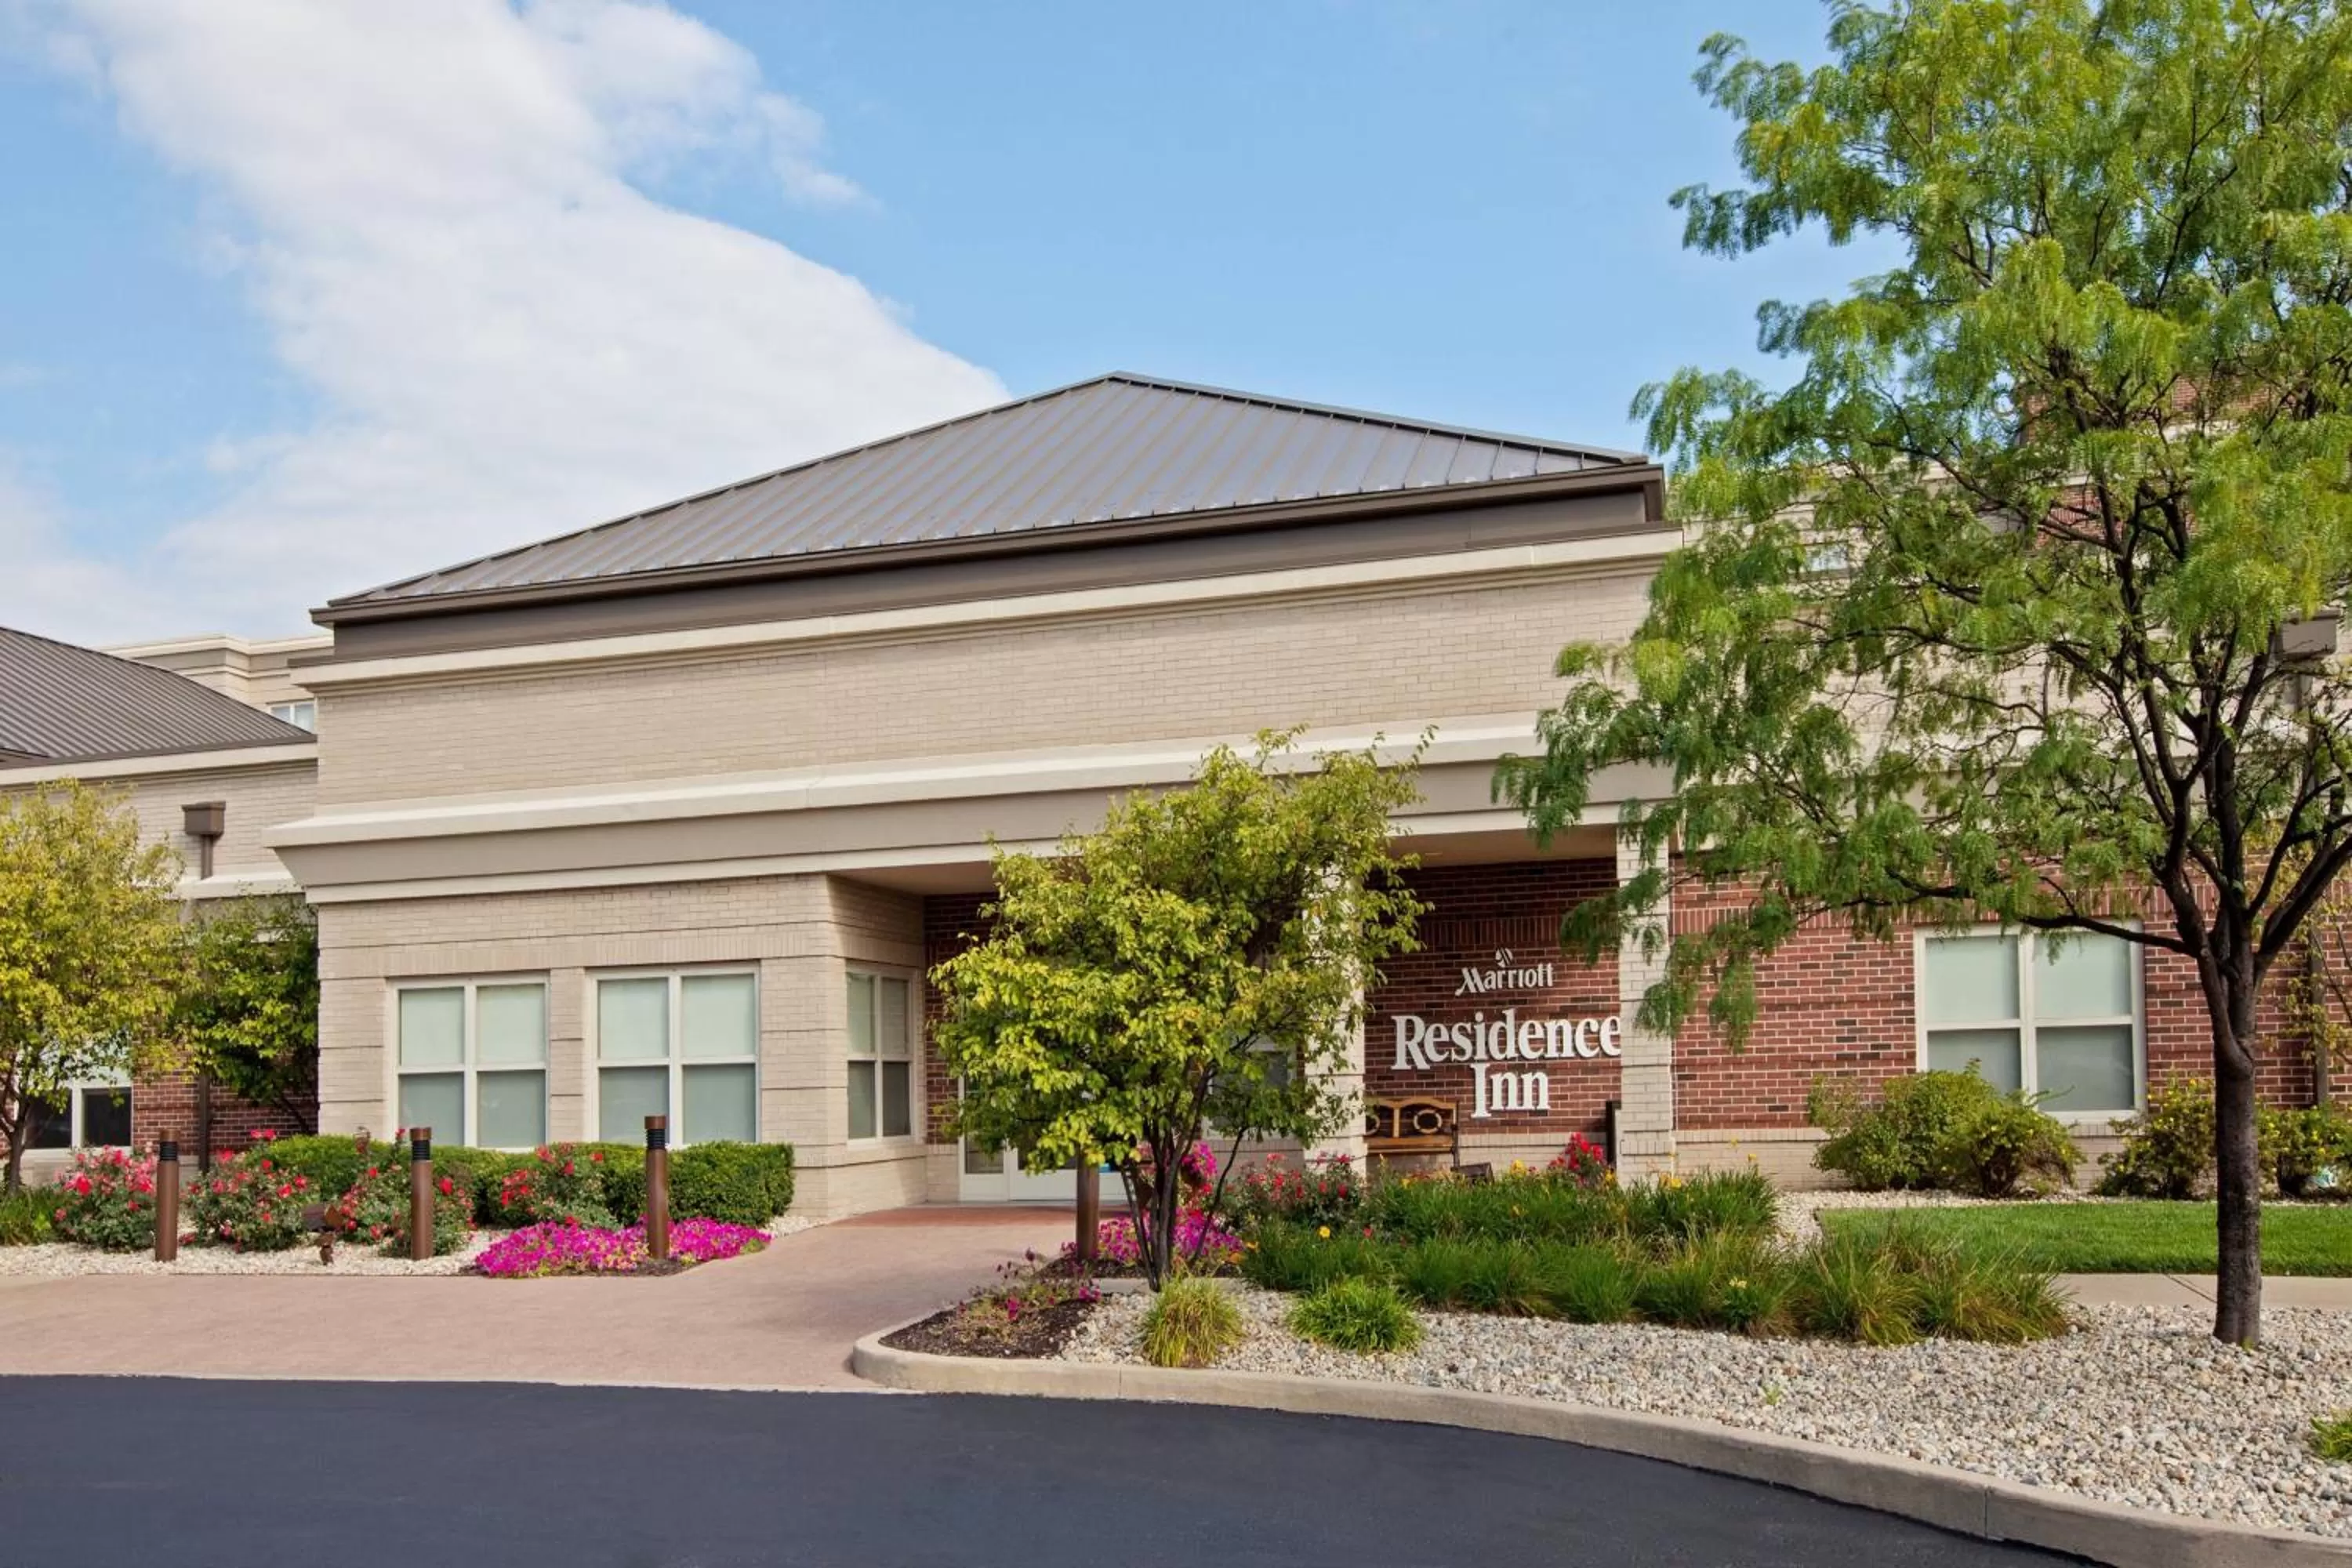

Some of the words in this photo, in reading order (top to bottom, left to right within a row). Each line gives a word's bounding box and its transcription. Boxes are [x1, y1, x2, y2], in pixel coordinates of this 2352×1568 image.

[1455, 964, 1554, 996] Marriott
[1391, 1008, 1621, 1070] Residence
[1470, 1063, 1550, 1119] Inn
